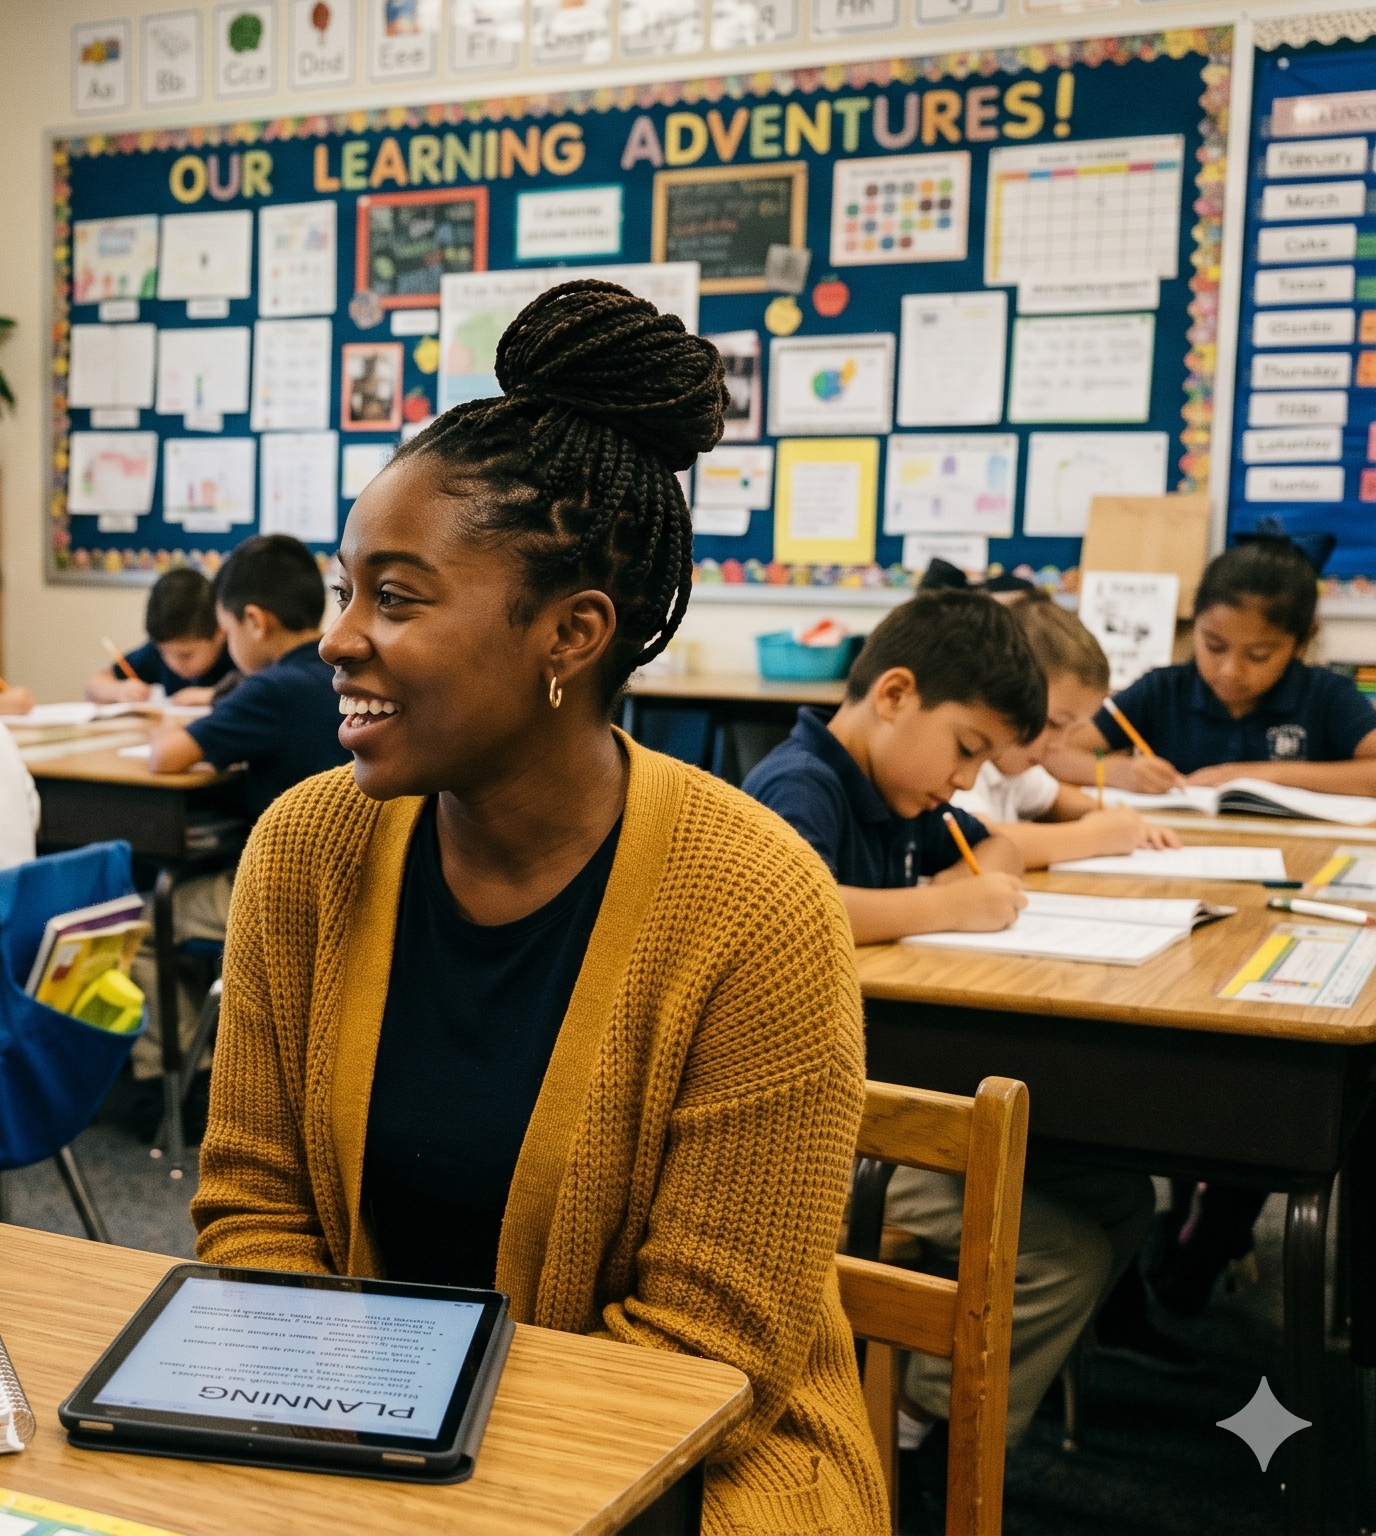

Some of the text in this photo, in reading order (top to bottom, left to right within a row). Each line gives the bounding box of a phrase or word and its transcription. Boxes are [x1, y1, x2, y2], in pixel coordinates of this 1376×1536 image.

[169, 70, 1075, 204] OUR LEARNING ADVENTURES!
[198, 1386, 416, 1420] PLANNING
